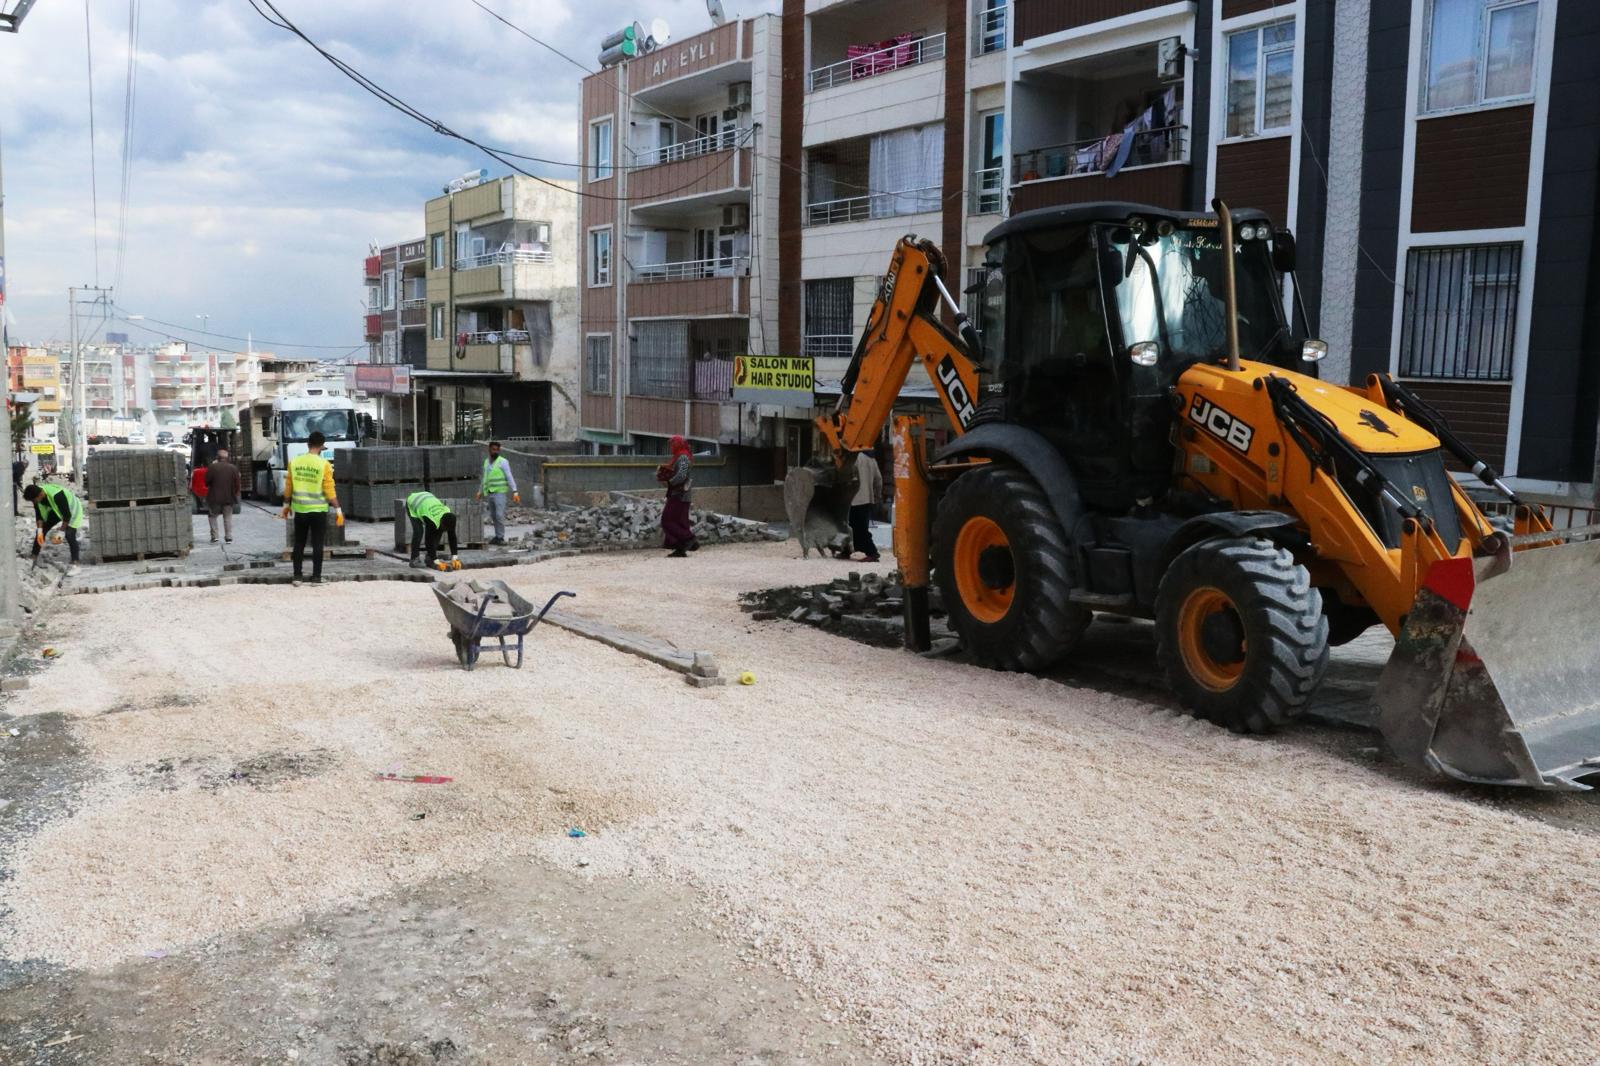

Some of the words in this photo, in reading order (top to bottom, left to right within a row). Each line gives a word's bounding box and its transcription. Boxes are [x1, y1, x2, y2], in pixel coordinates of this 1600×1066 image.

[750, 358, 788, 370] SALON
[791, 359, 810, 371] MK
[751, 372, 773, 386] HAIR
[775, 373, 812, 389] STUDIO
[1190, 401, 1252, 452] JCB
